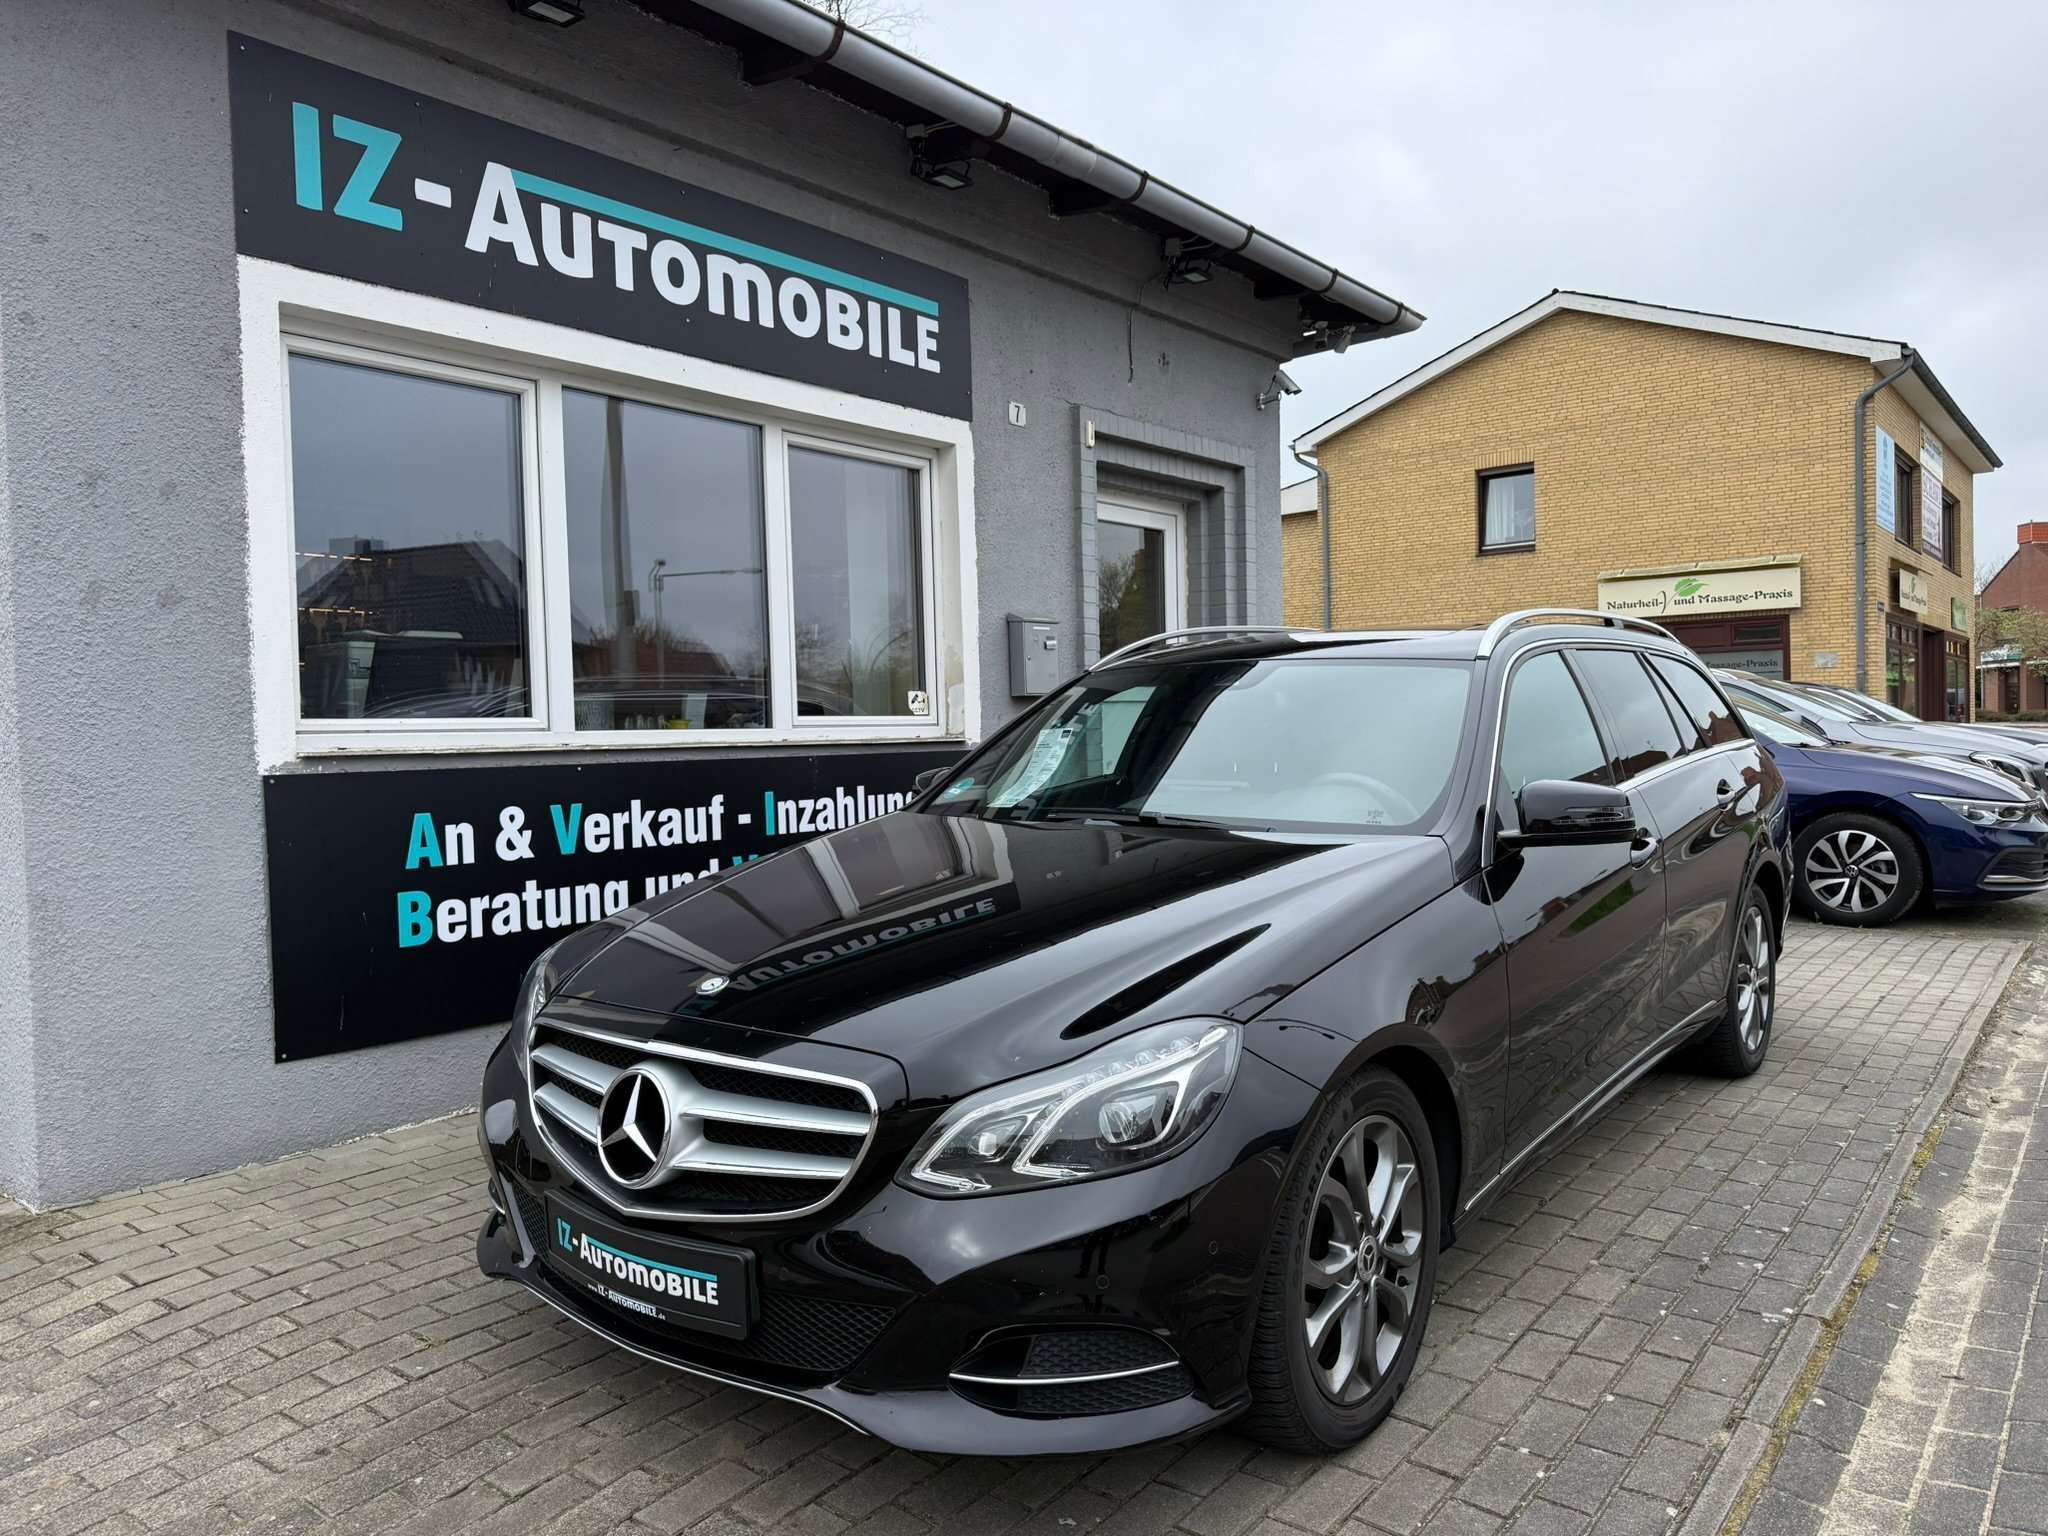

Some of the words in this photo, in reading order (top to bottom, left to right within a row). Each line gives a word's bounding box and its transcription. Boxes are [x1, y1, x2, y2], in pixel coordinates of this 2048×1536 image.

[1014, 404, 1021, 423] 7
[1674, 595, 1695, 606] und
[1698, 589, 1793, 604] Massage-Praxis
[405, 812, 474, 870] An
[496, 805, 534, 859] &
[550, 795, 724, 855] Verkauf
[396, 880, 629, 948] Beratung
[557, 1217, 719, 1305] IZ-AUTOMOBILE
